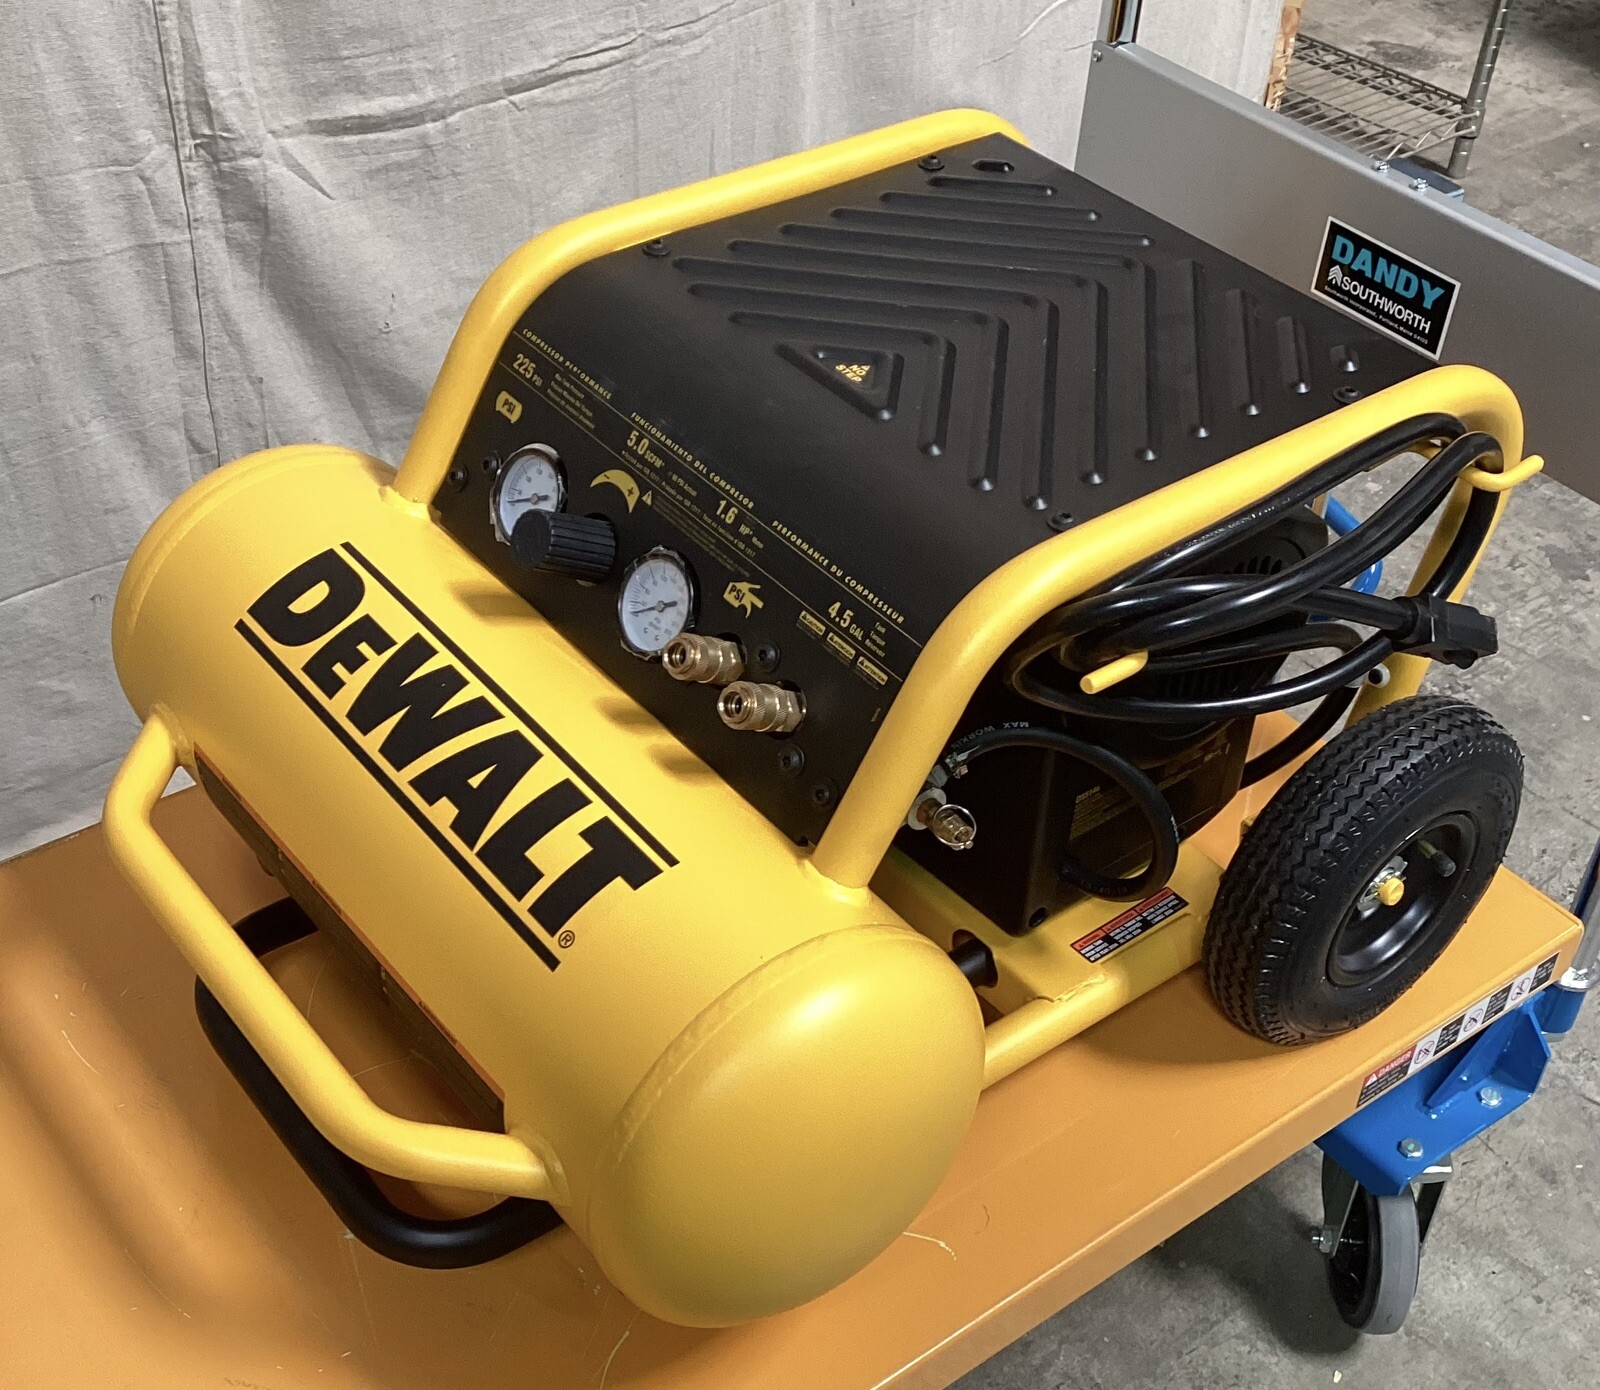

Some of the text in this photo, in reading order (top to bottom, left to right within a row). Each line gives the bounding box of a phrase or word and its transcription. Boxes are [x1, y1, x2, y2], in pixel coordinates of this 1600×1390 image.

[1331, 235, 1445, 310] DANDY
[1341, 276, 1431, 334] SOUTHWORTH
[512, 353, 537, 379] 225
[522, 328, 564, 363] COMPRESSOR
[564, 360, 612, 400] PERFORMANCE
[835, 364, 862, 382] STEP
[849, 364, 867, 376] NO
[502, 397, 516, 416] PSI
[626, 430, 650, 455] 5.0
[630, 412, 693, 462] FUNCIONAMIENTO
[694, 460, 708, 475] DEL
[709, 472, 755, 510] COMPRESOR
[715, 499, 739, 525] 1.6
[771, 520, 829, 567] PERFORMANCE
[830, 564, 844, 578] DU
[844, 576, 905, 625] COMPRESSEUR
[728, 584, 746, 603] PSI
[827, 601, 854, 628] 4.5
[848, 623, 866, 641] GAL
[1002, 721, 1029, 729] MAX
[1377, 1050, 1412, 1079] DANGER
